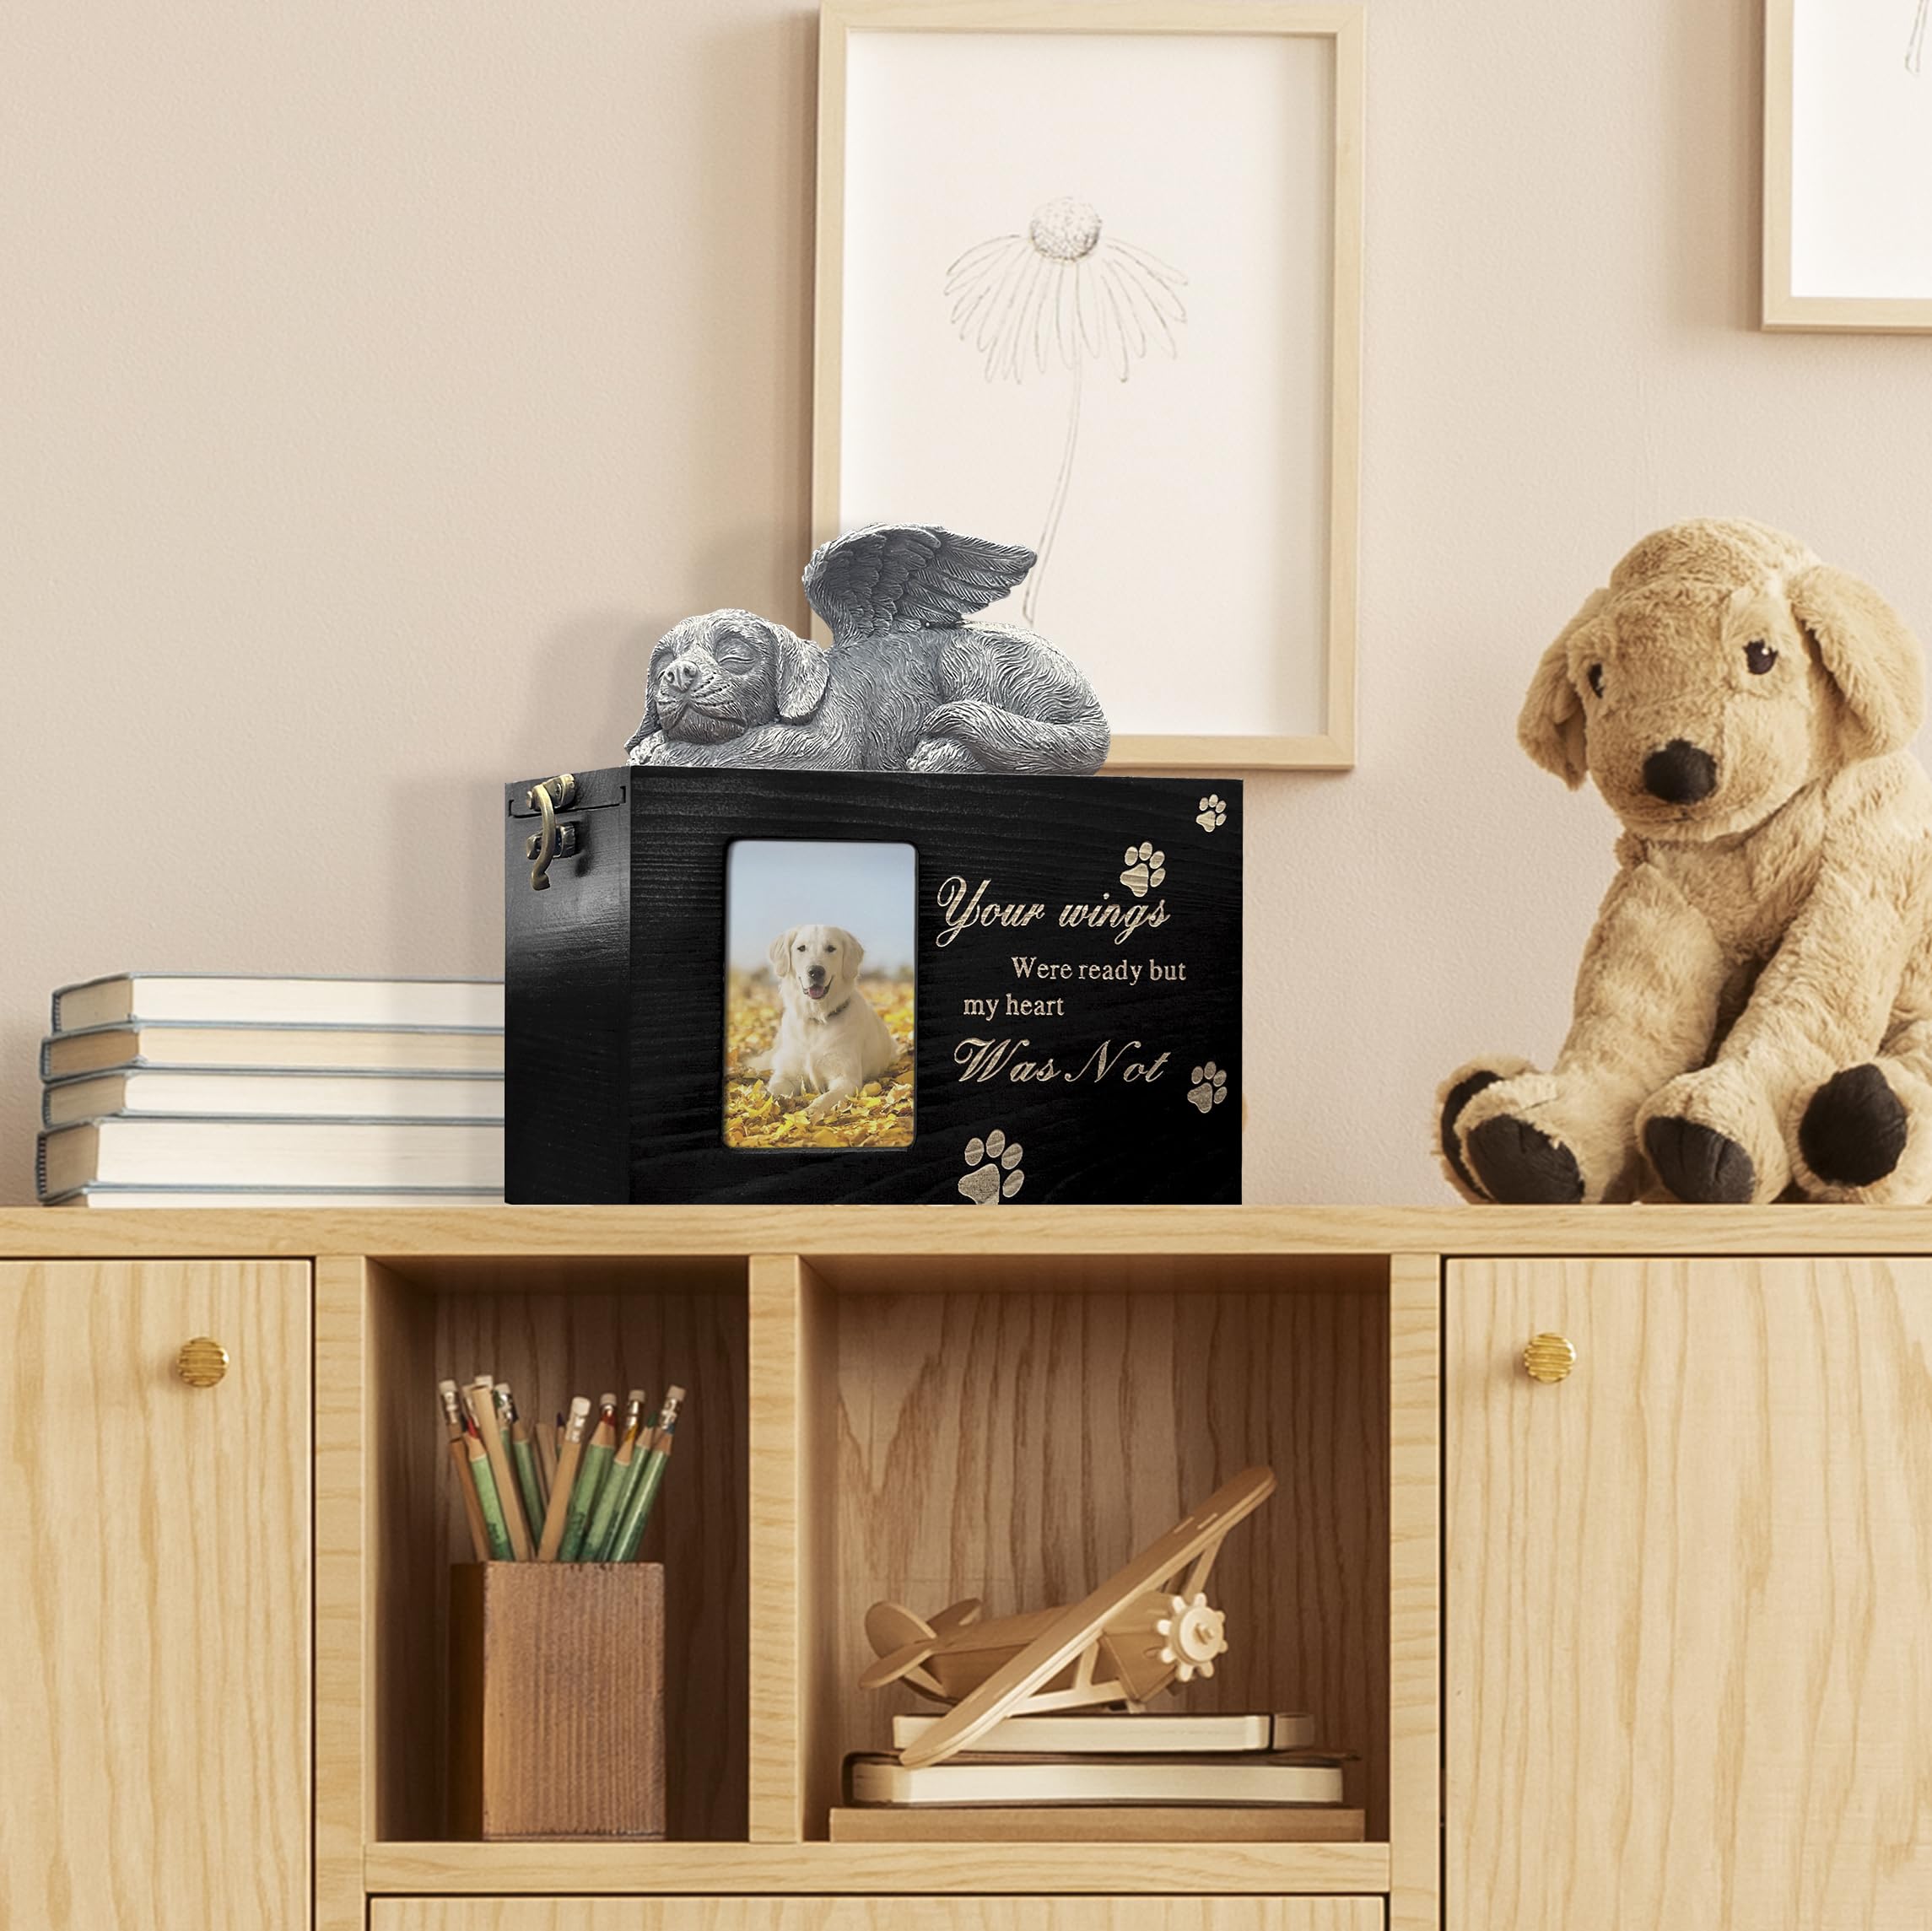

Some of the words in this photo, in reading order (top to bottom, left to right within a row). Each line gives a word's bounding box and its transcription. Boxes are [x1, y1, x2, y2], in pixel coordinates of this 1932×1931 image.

[936, 876, 1045, 947] Your
[1058, 892, 1172, 945] wings
[1012, 956, 1073, 979] Were
[1078, 959, 1143, 986] ready
[1149, 958, 1187, 981] but
[963, 997, 1000, 1021] my
[1005, 993, 1066, 1017] heart
[953, 1037, 1061, 1083] Was
[1064, 1038, 1172, 1083] Not
